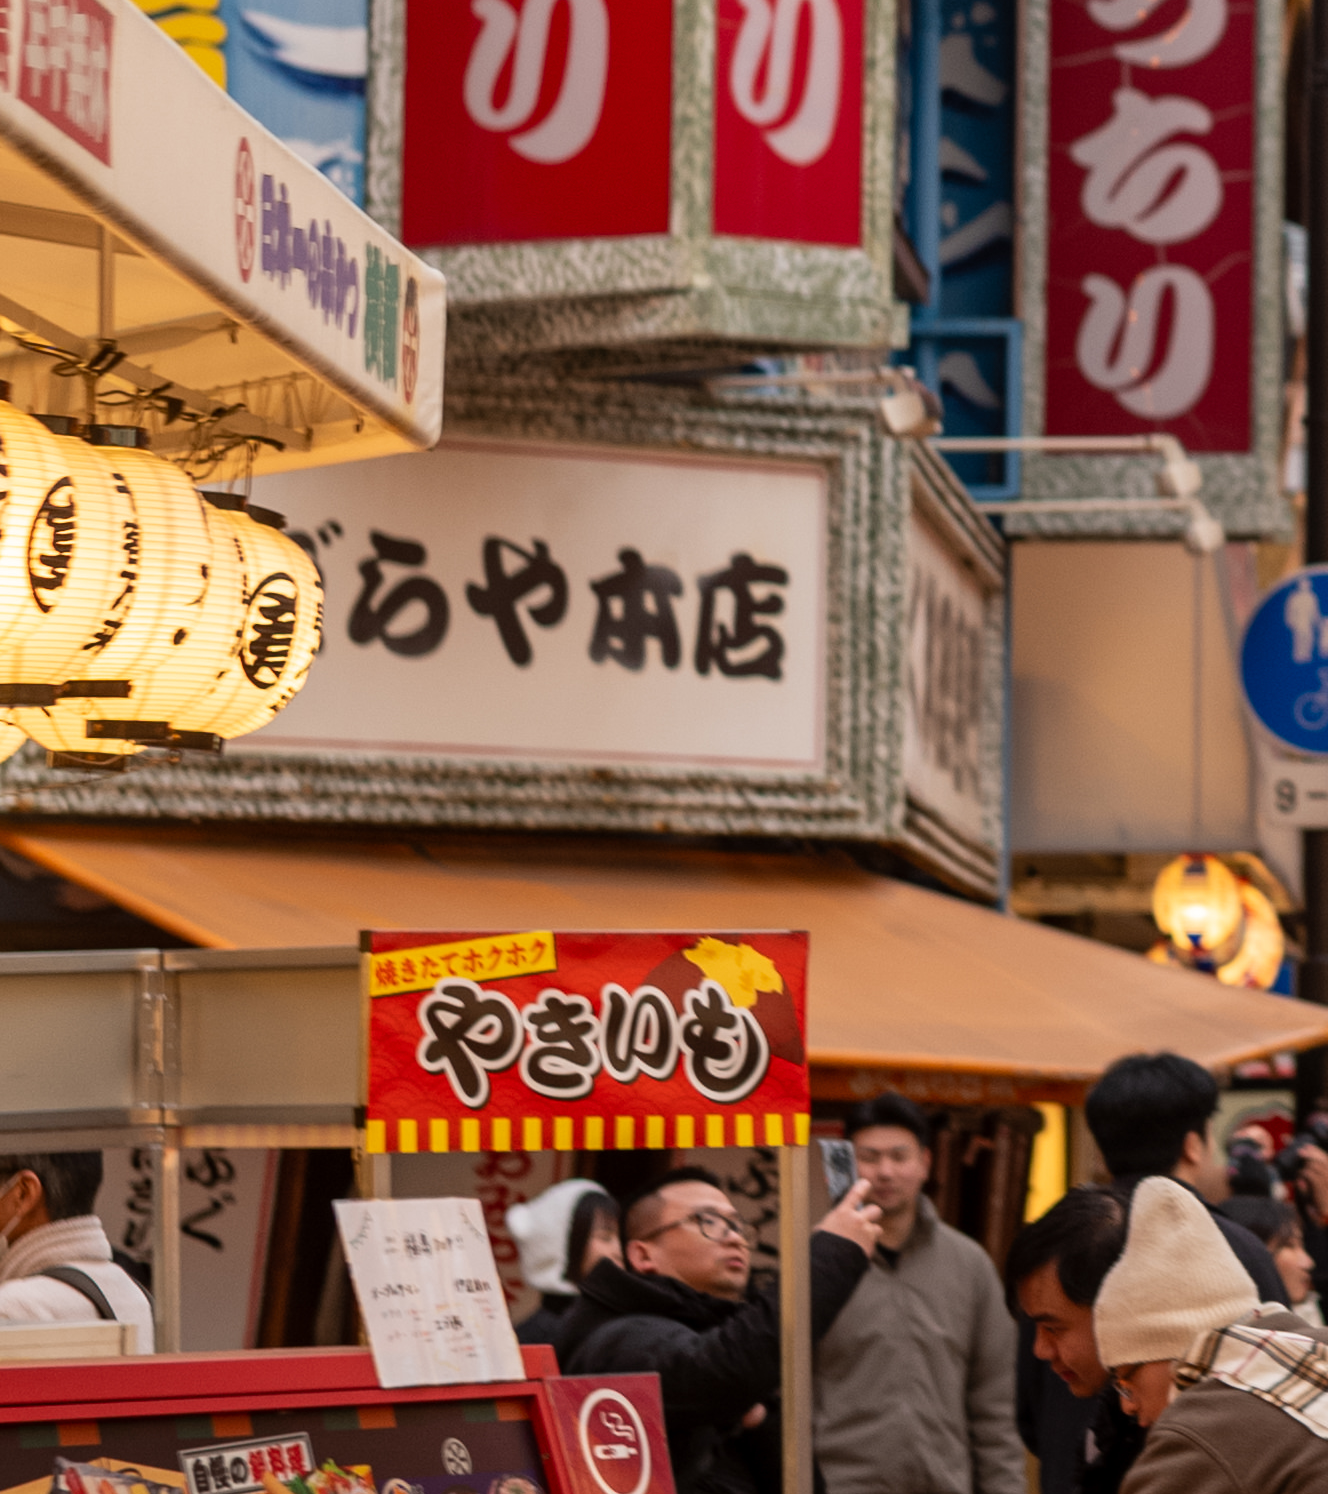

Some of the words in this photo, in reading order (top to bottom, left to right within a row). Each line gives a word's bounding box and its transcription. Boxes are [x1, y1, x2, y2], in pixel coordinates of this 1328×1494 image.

[290, 520, 790, 681] らや本店
[373, 937, 547, 988] 焼きたてホクホク
[422, 981, 768, 1105] やきいも
